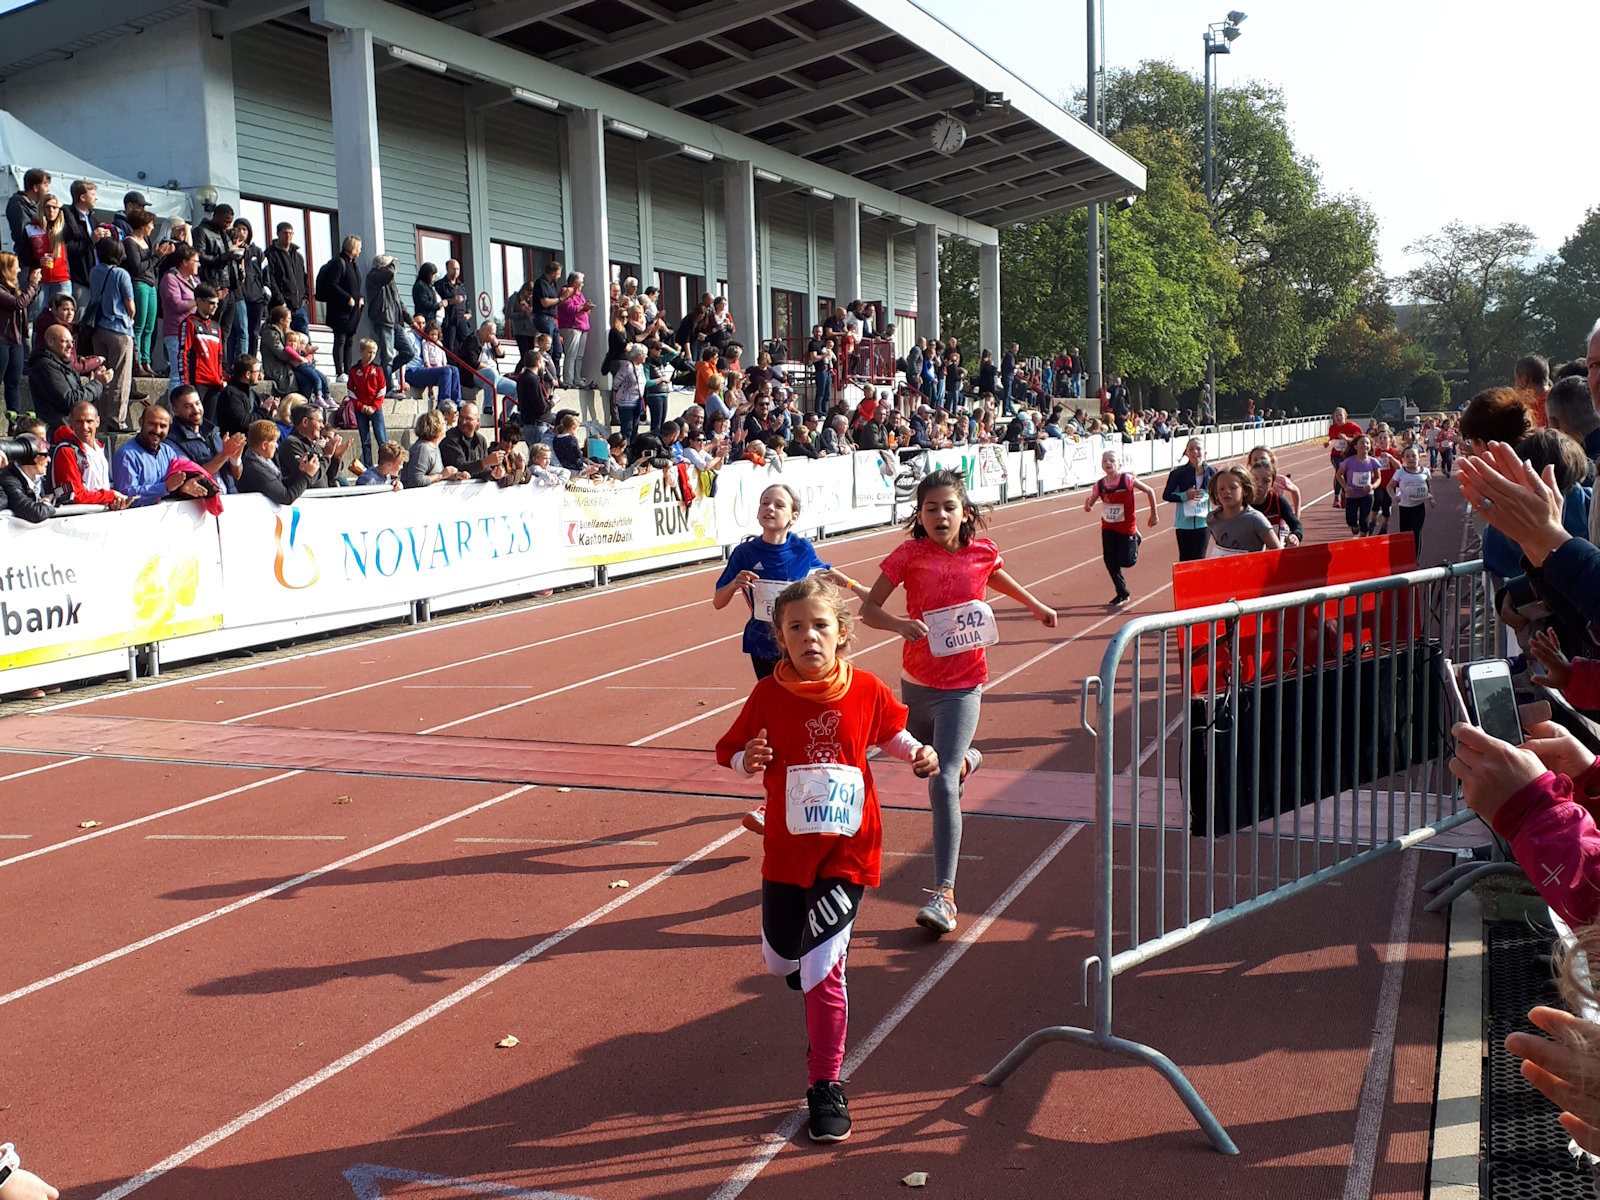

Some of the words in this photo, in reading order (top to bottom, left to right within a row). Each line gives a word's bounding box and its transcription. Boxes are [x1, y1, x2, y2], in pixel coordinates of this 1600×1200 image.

[654, 505, 689, 537] RUN
[340, 509, 535, 582] NOVARTIS
[578, 528, 633, 546] Kantonalbank
[0, 593, 82, 636] bank
[957, 610, 985, 631] 542
[945, 630, 982, 648] GIULIA
[828, 778, 855, 806] 761
[804, 805, 850, 825] VIVIAN
[808, 884, 853, 938] RUN
